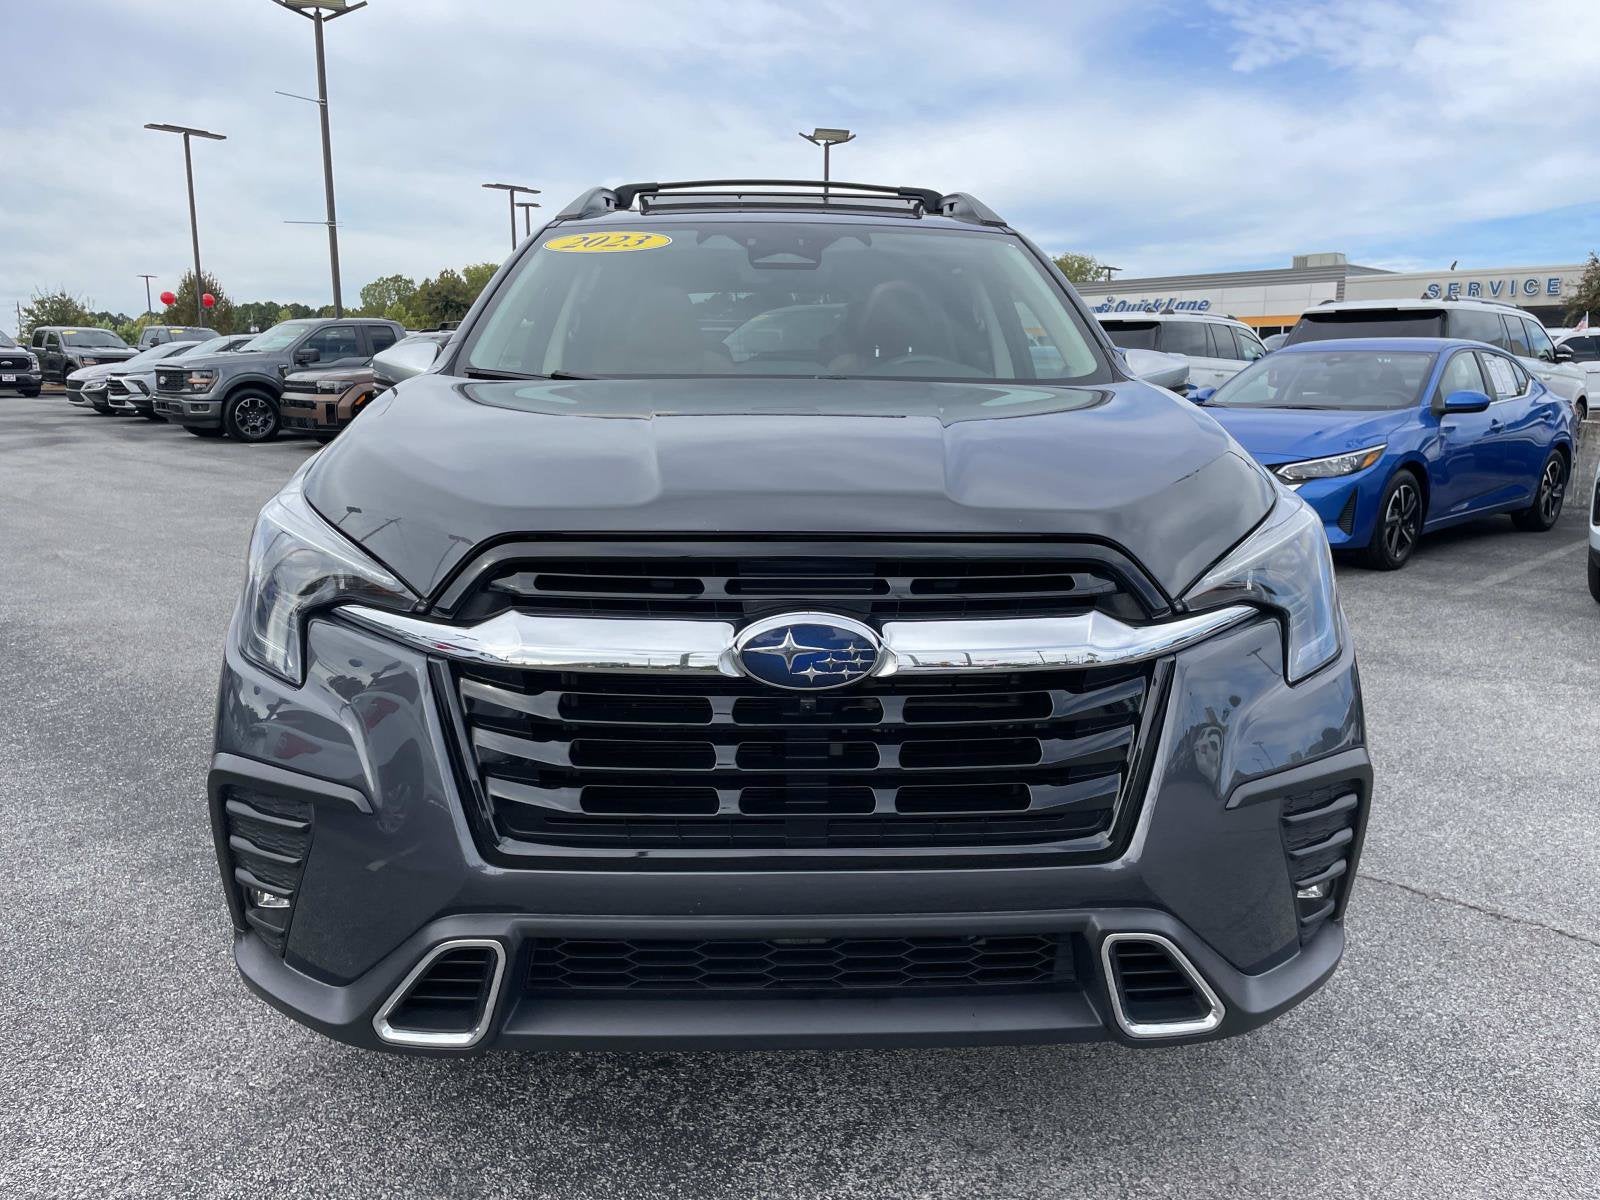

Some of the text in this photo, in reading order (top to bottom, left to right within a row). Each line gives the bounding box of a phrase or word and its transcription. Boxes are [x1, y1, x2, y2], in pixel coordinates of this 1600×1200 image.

[562, 235, 652, 248] 2023
[1427, 277, 1562, 299] SERVICE
[1114, 297, 1211, 314] Quick Lane
